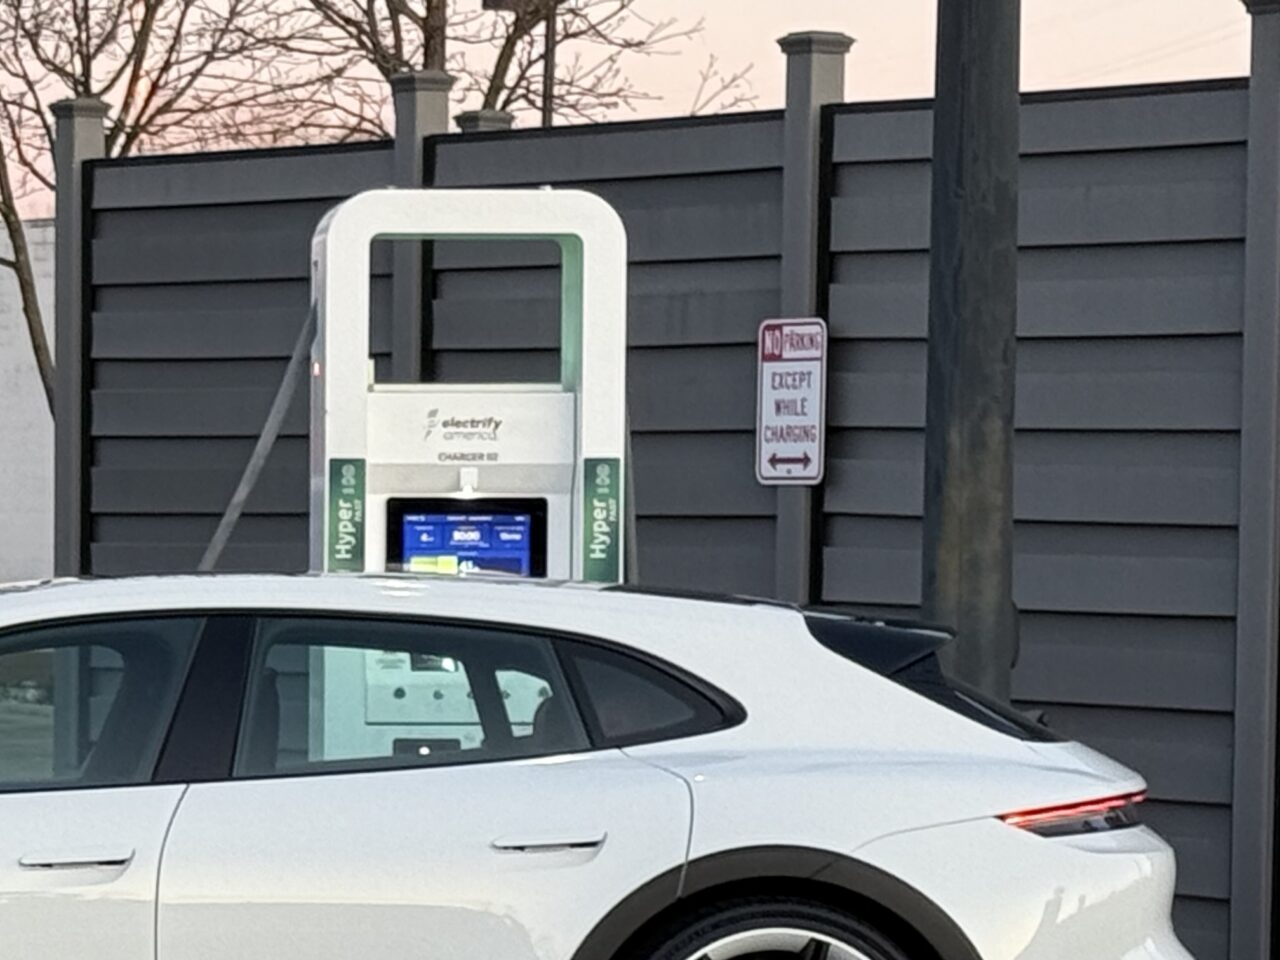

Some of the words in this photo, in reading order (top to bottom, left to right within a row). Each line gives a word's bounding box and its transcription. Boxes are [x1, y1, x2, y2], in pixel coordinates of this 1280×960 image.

[764, 329, 781, 356] NO
[784, 331, 822, 352] PARKING
[771, 371, 812, 391] EXCEPT
[774, 398, 808, 416] WHILE
[441, 416, 503, 434] electrify
[764, 425, 817, 444] CHARGING
[442, 431, 498, 441] america
[438, 452, 485, 462] CHARGER
[335, 499, 357, 559] Hyper
[589, 499, 611, 559] Hyper
